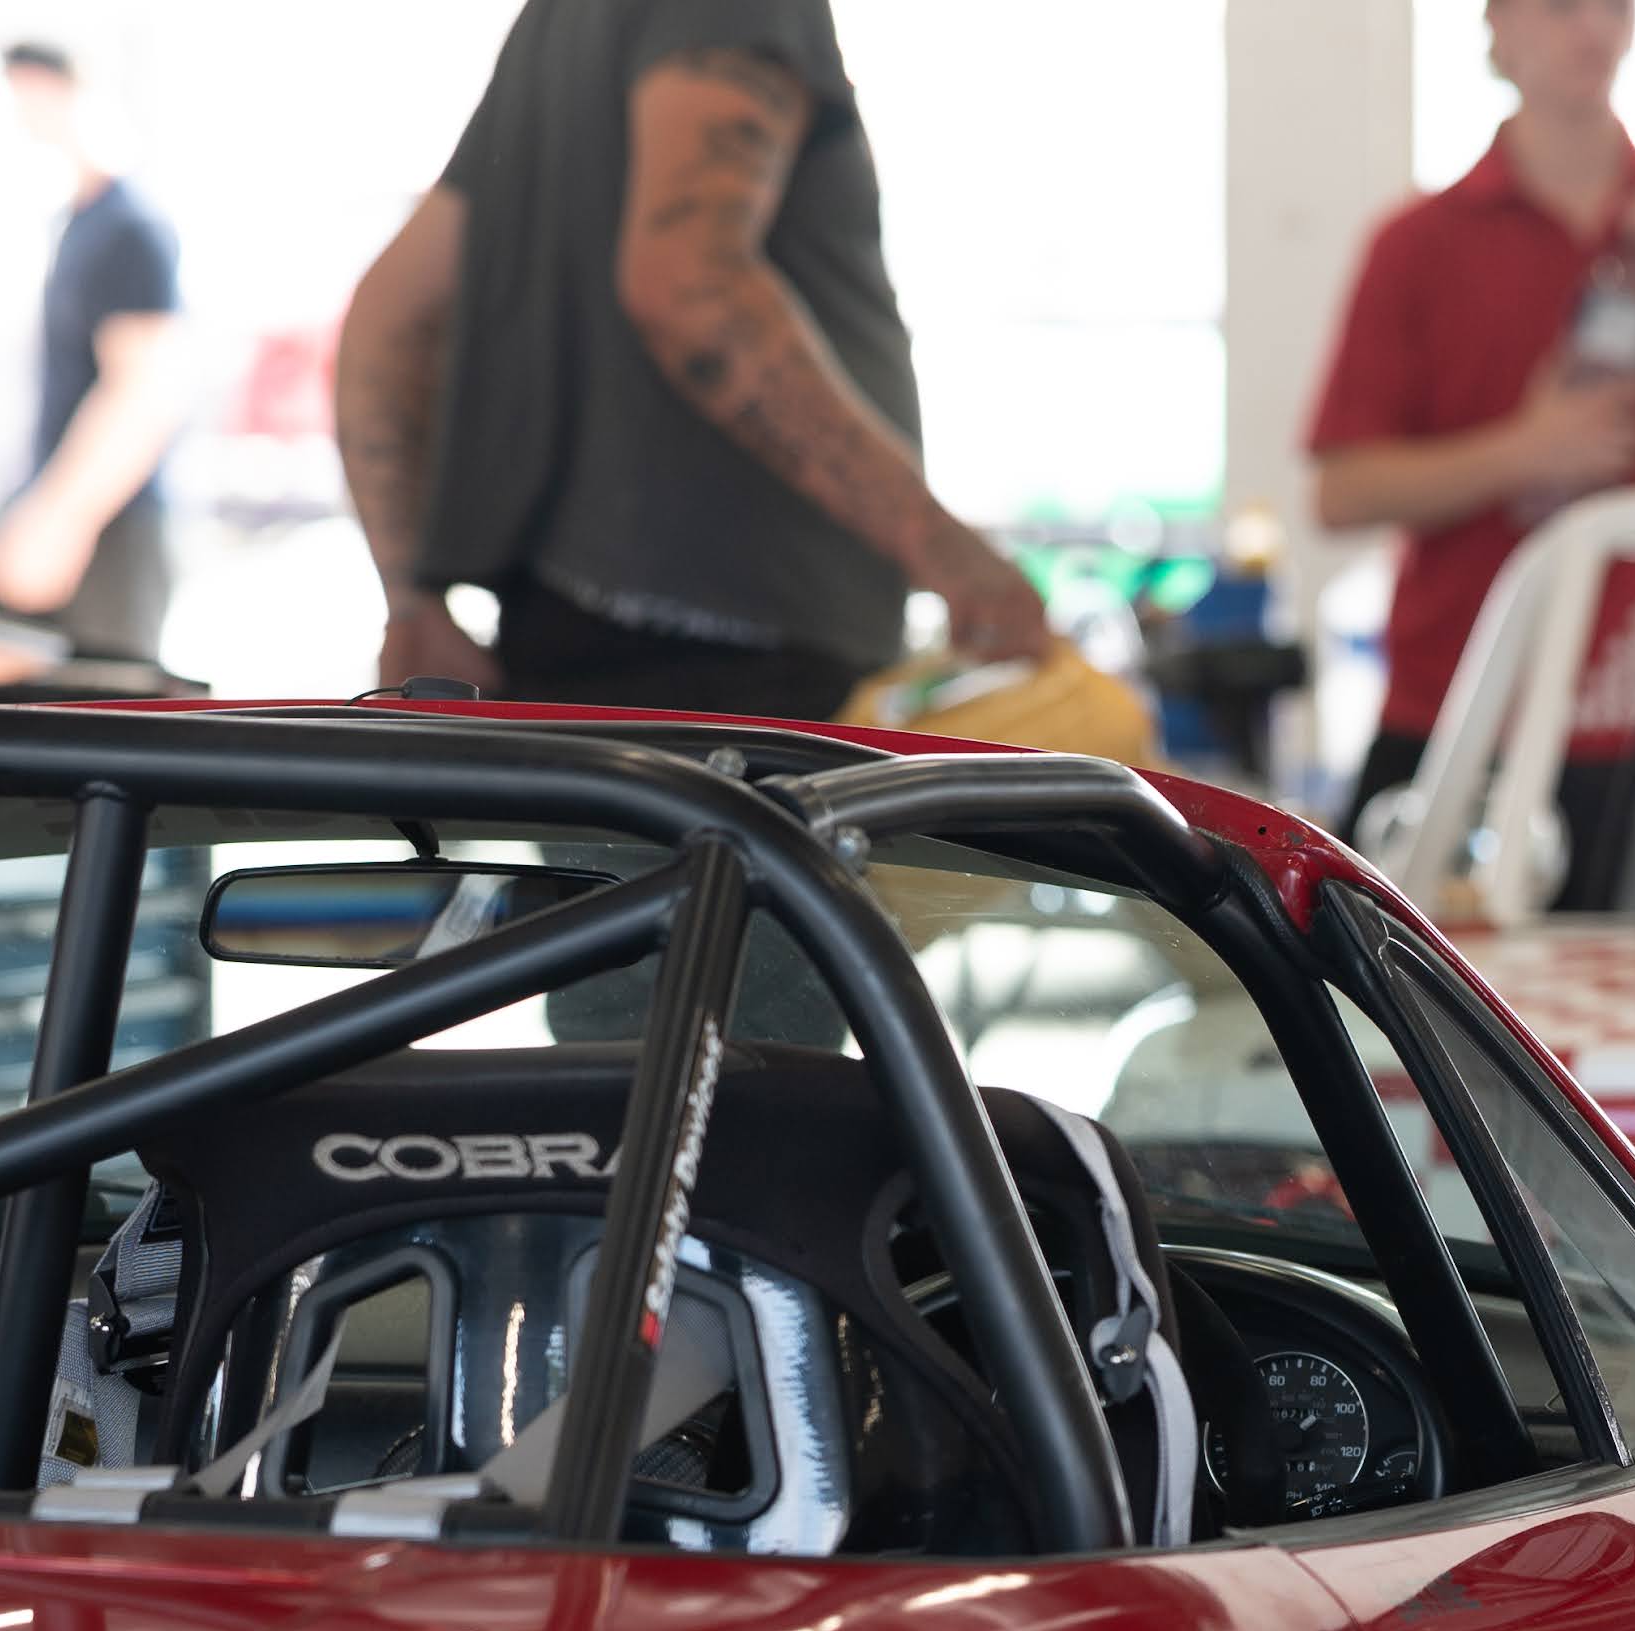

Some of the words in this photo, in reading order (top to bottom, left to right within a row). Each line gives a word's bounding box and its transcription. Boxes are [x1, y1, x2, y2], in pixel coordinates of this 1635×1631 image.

[1309, 1375, 1327, 1387] 80
[1335, 1403, 1357, 1415] 100
[1340, 1447, 1362, 1458] 120
